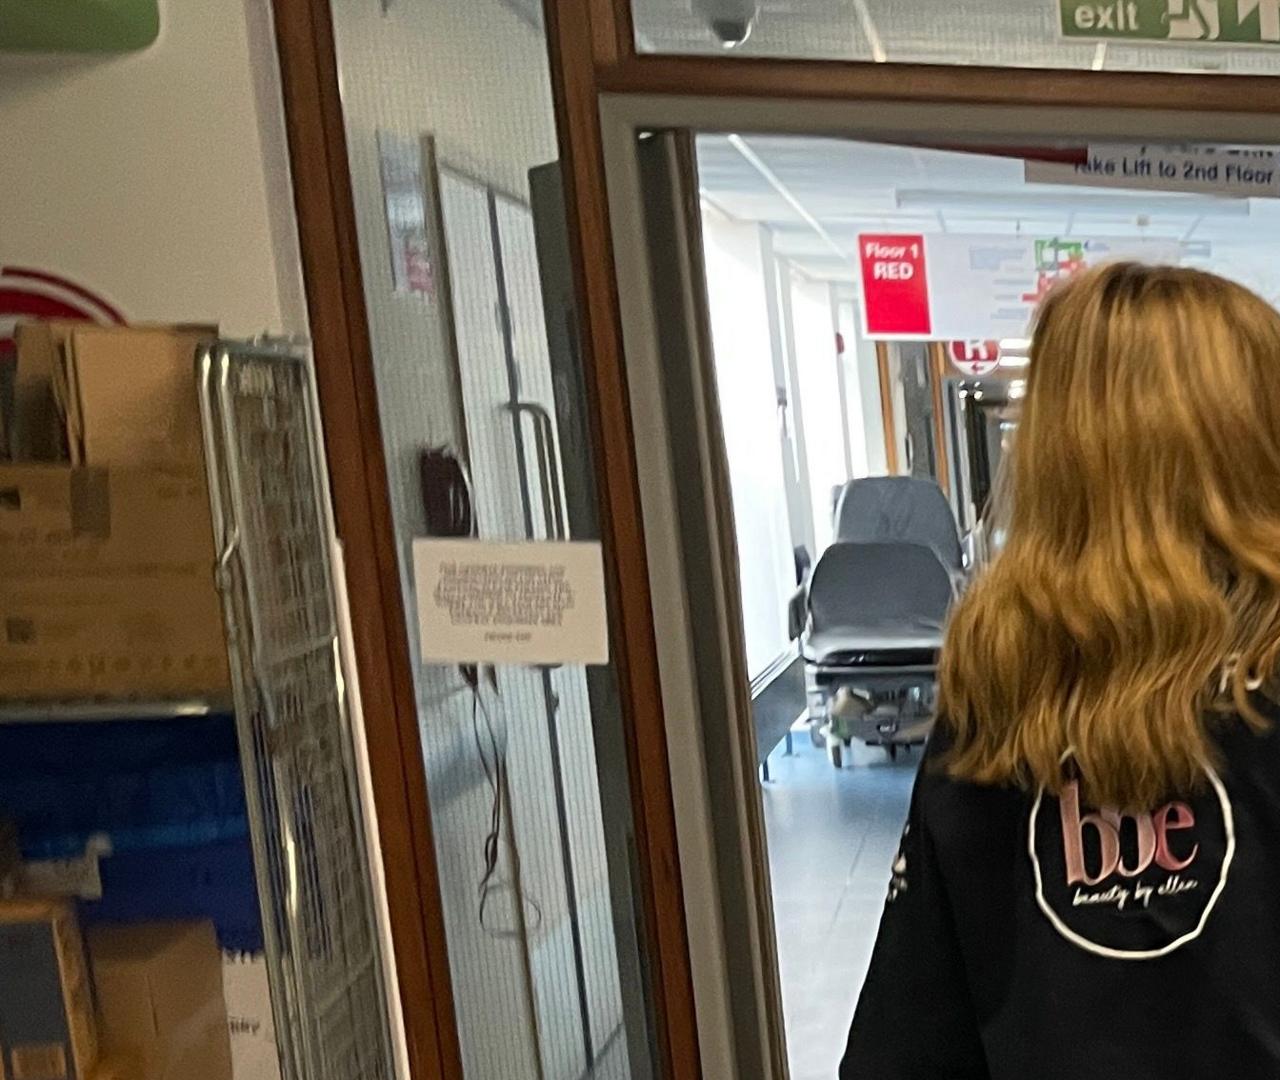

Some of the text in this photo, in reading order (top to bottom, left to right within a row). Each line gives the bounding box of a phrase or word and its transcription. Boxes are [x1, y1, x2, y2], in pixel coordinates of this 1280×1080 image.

[1074, 1, 1139, 31] exit
[1159, 163, 1177, 179] to
[1183, 163, 1219, 182] 2nd
[1225, 165, 1274, 185] Floor
[865, 241, 919, 259] Floor 1
[873, 262, 914, 280] RED
[1134, 881, 1154, 908] by
